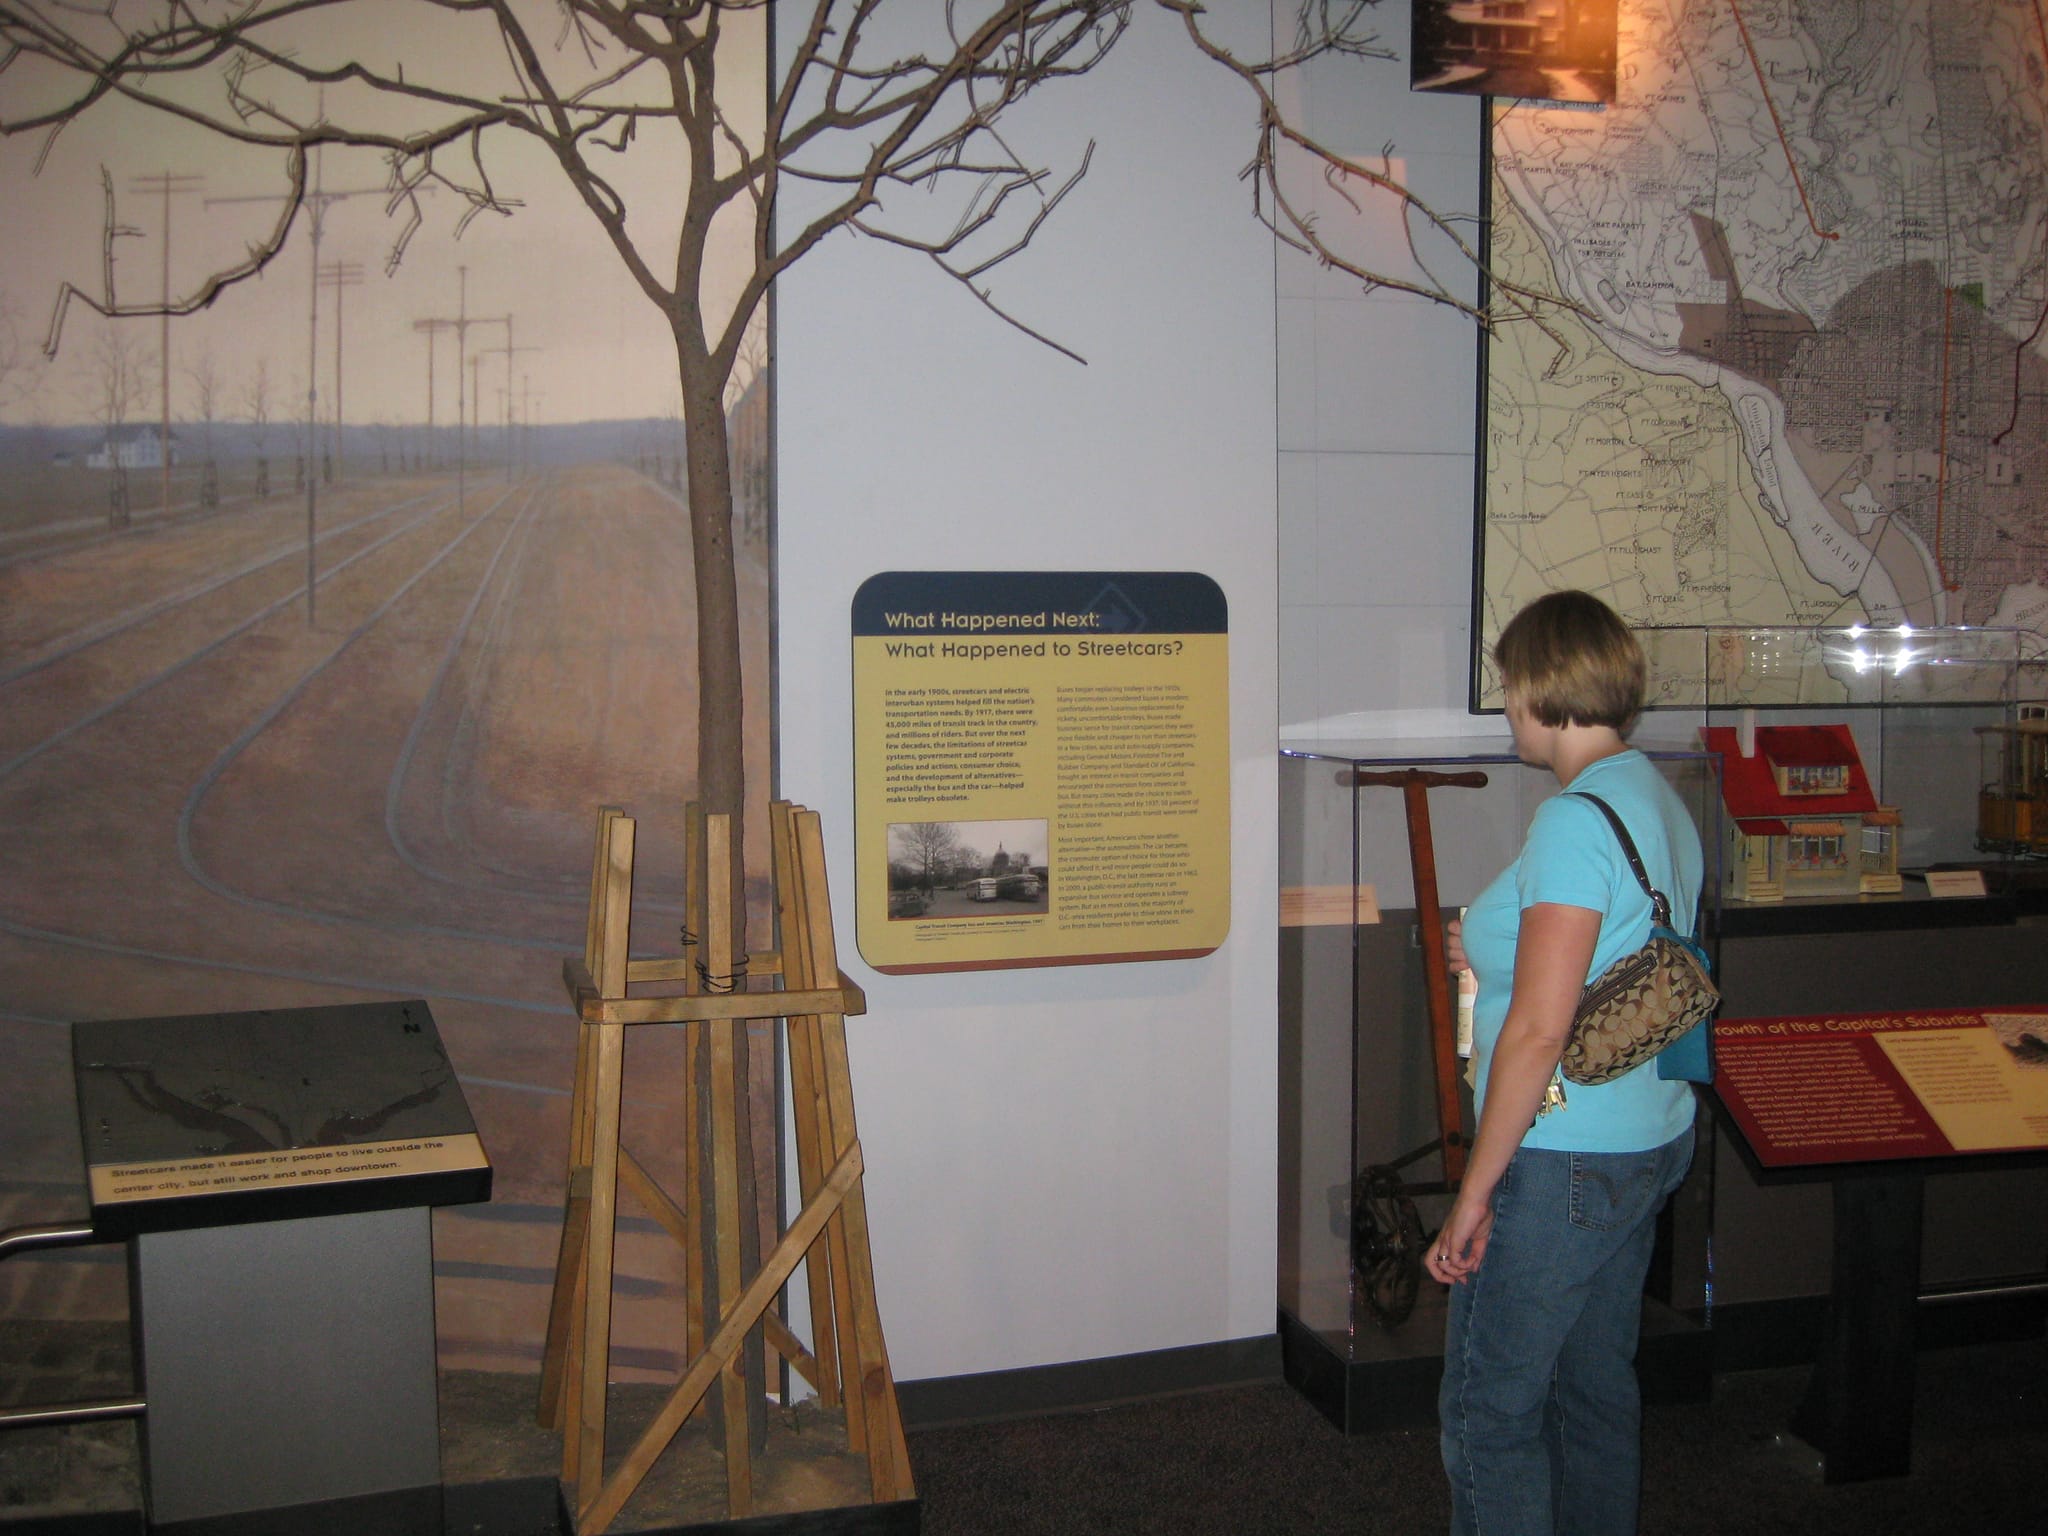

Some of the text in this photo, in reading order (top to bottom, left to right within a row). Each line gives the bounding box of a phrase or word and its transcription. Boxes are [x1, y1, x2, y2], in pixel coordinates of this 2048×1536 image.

[885, 612, 1099, 631] What Happened Next:
[885, 640, 1183, 660] What Happened to Streetcars?
[1009, 719, 1038, 727] country,
[886, 764, 914, 772] policies
[886, 785, 922, 793] especially
[403, 1023, 421, 1033] N
[1715, 1014, 1980, 1036] rowth of the Capital's Suburbs
[112, 1166, 176, 1178] Streetcars
[180, 1163, 214, 1171] made
[230, 1158, 268, 1166] easier
[292, 1151, 333, 1162] people
[352, 1148, 374, 1156] live
[377, 1144, 421, 1154] outside
[114, 1162, 401, 1194] center city, but still work and shop downtown.
